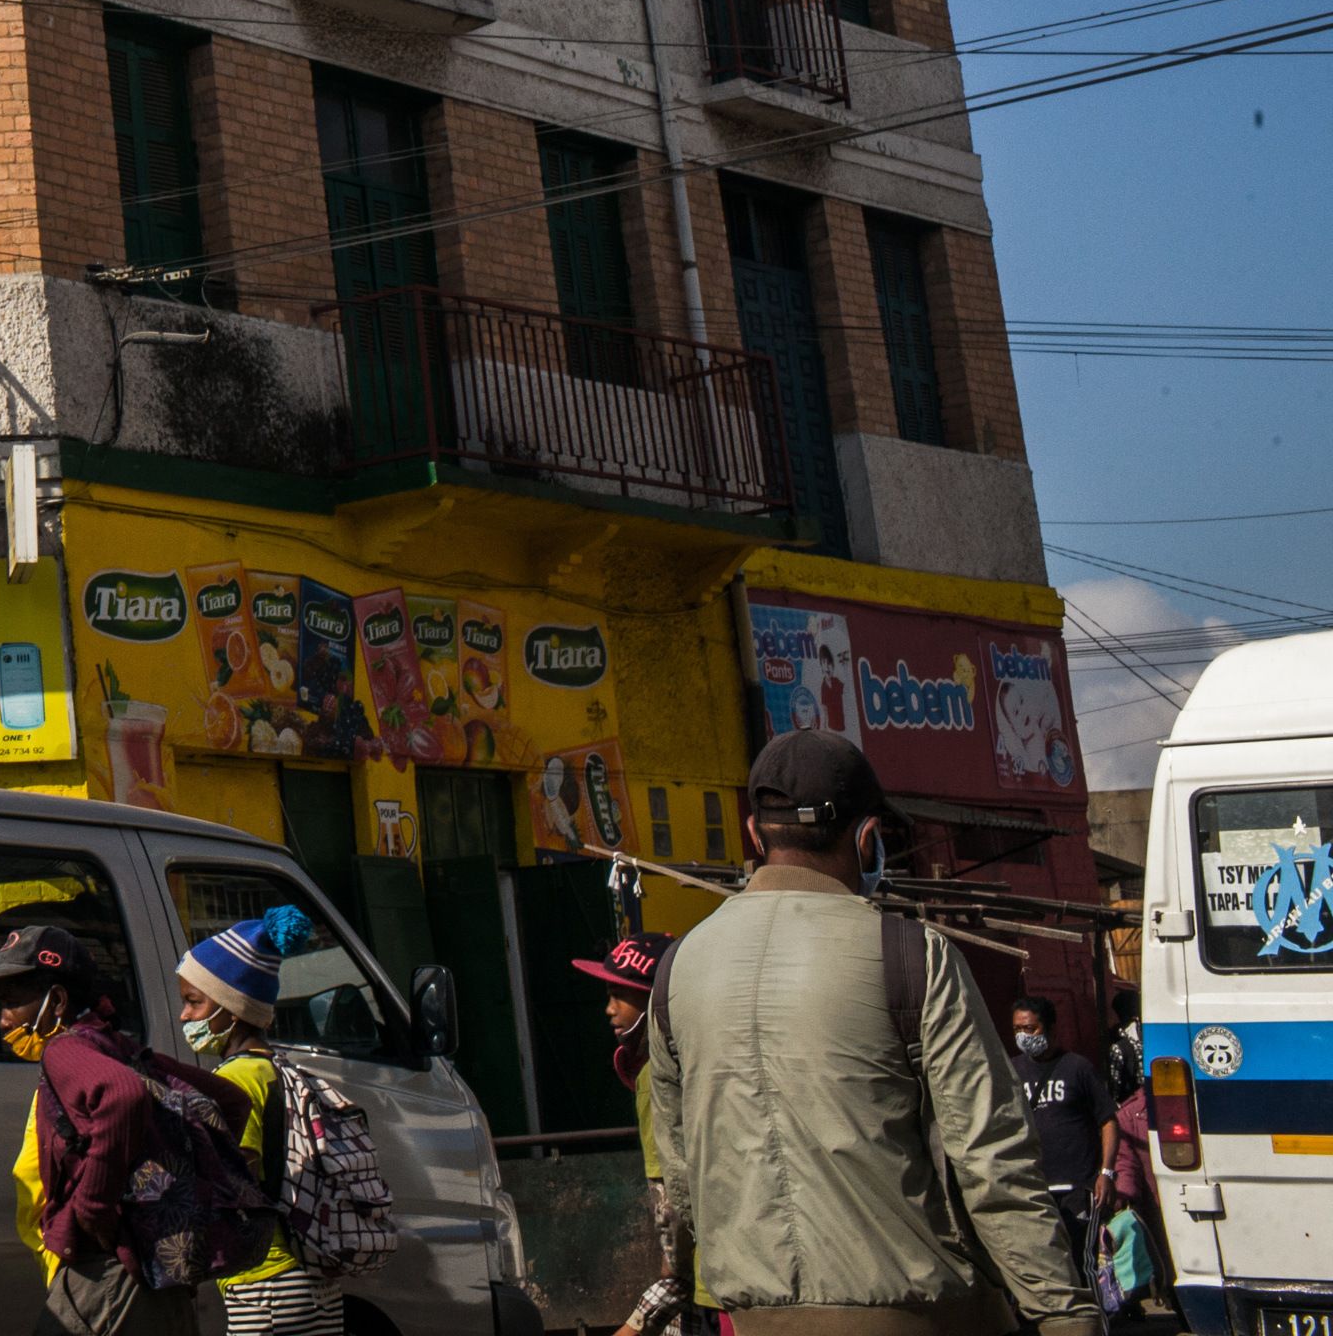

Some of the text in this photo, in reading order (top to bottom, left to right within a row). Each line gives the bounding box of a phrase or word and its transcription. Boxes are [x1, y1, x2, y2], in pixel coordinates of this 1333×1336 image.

[96, 582, 182, 622] Tiara
[200, 591, 237, 613] Tiara
[255, 597, 293, 618] Tiara
[308, 609, 345, 636] Tiara
[366, 618, 401, 641] Tiara
[415, 621, 450, 641] Tiara
[464, 625, 499, 649] Tiara
[533, 634, 603, 671] Tiara
[990, 642, 1052, 681] bebem
[764, 662, 794, 681] Pants
[858, 657, 974, 731] bebem
[2, 734, 23, 743] ONE
[0, 748, 11, 756] 24
[33, 746, 45, 754] 92
[589, 763, 616, 841] Tiara
[1218, 866, 1244, 884] TSY
[1204, 1044, 1232, 1064] 75
